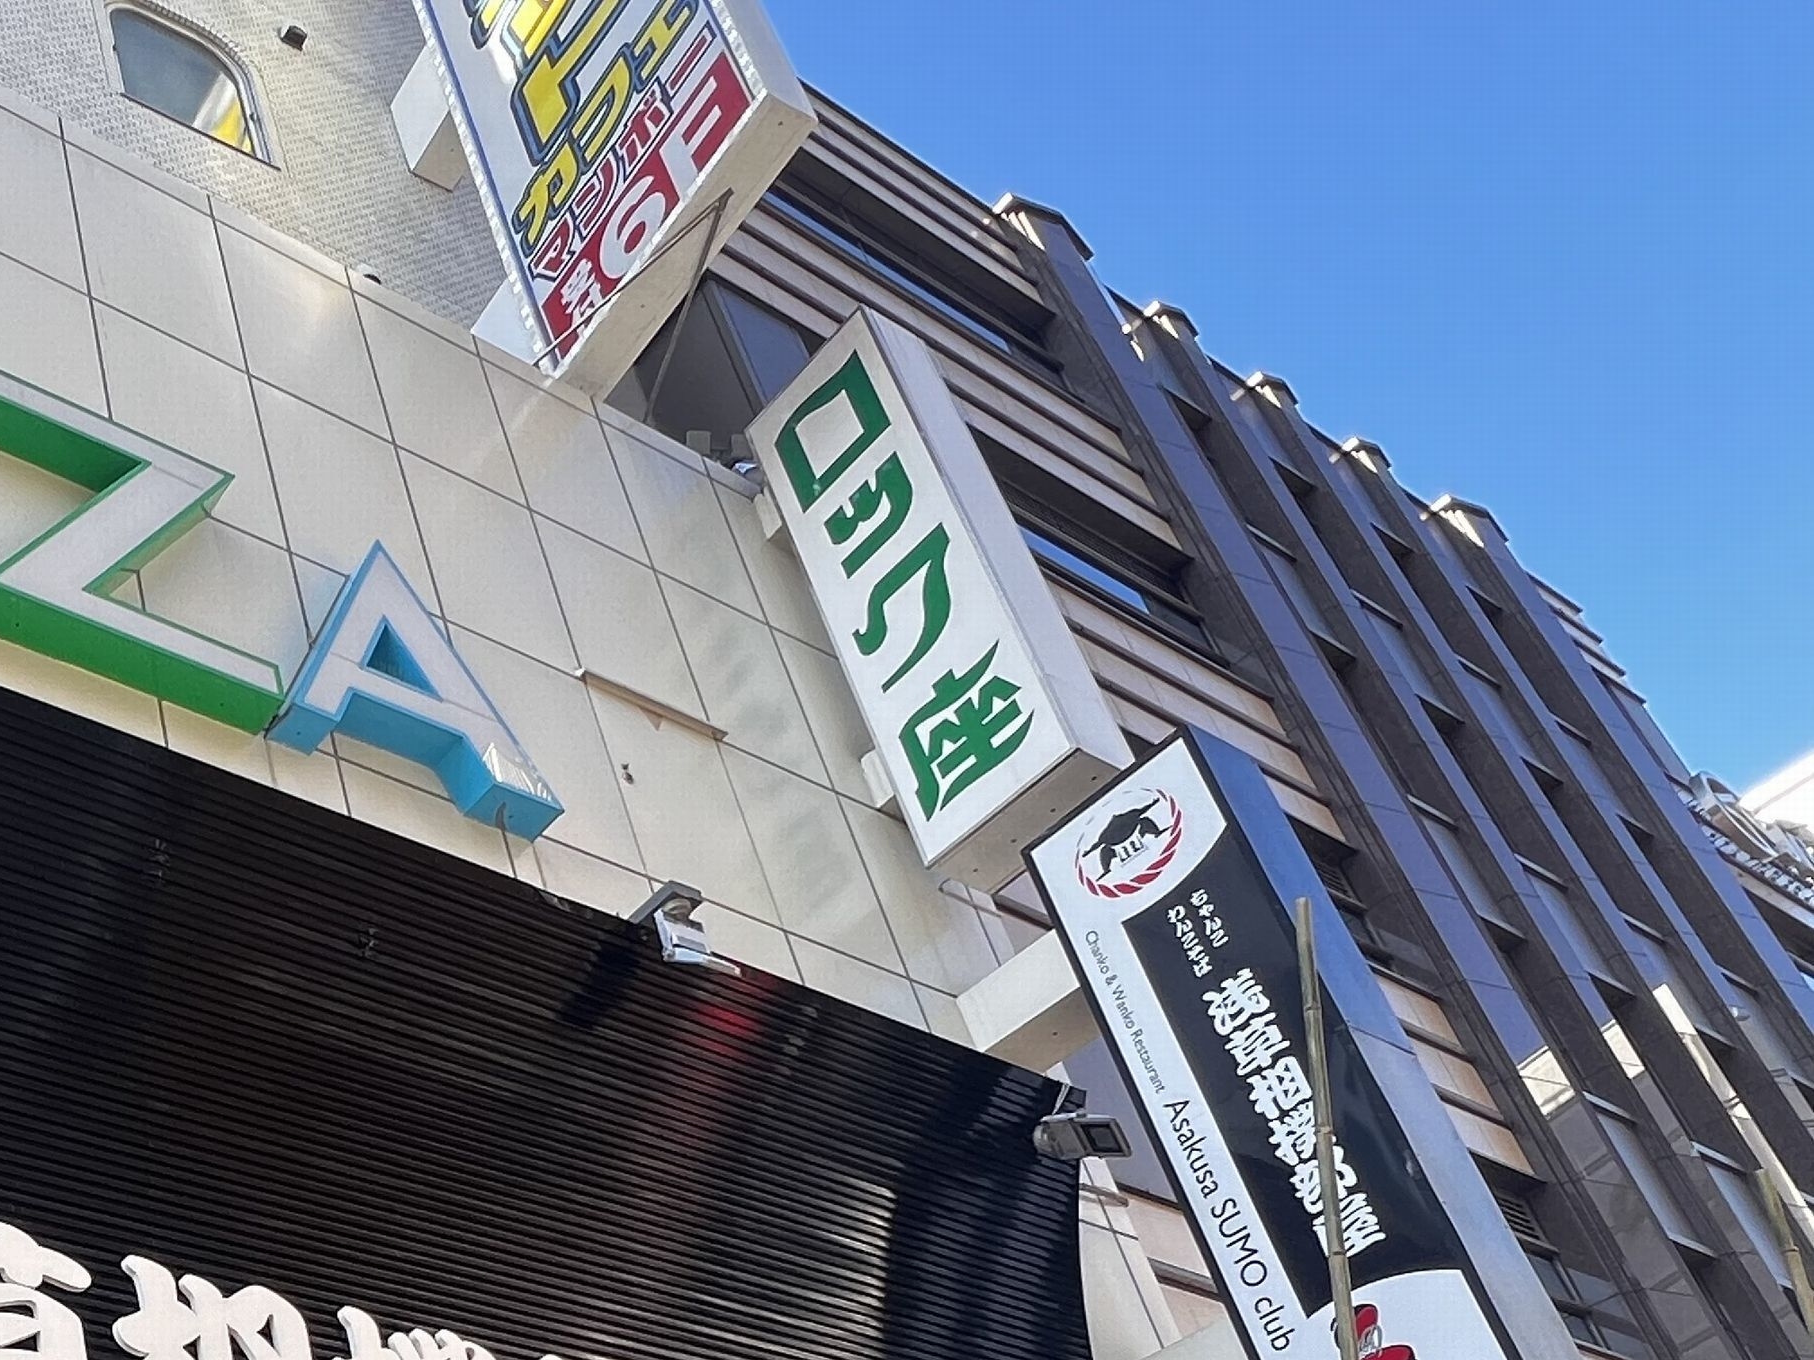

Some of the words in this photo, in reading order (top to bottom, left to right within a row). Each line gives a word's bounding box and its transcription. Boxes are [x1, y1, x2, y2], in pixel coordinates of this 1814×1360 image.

[514, 0, 698, 256] カフェ
[529, 22, 717, 281] マンボー
[599, 73, 722, 280] 6F
[774, 349, 1035, 822] ロック座
[1085, 930, 1111, 976] Chanko
[1112, 985, 1136, 1031] Wanko
[1129, 1028, 1167, 1095] Restaurant
[1163, 1099, 1220, 1199] Asakusa
[1211, 1197, 1268, 1289] SUMO
[1253, 1296, 1297, 1353] club
